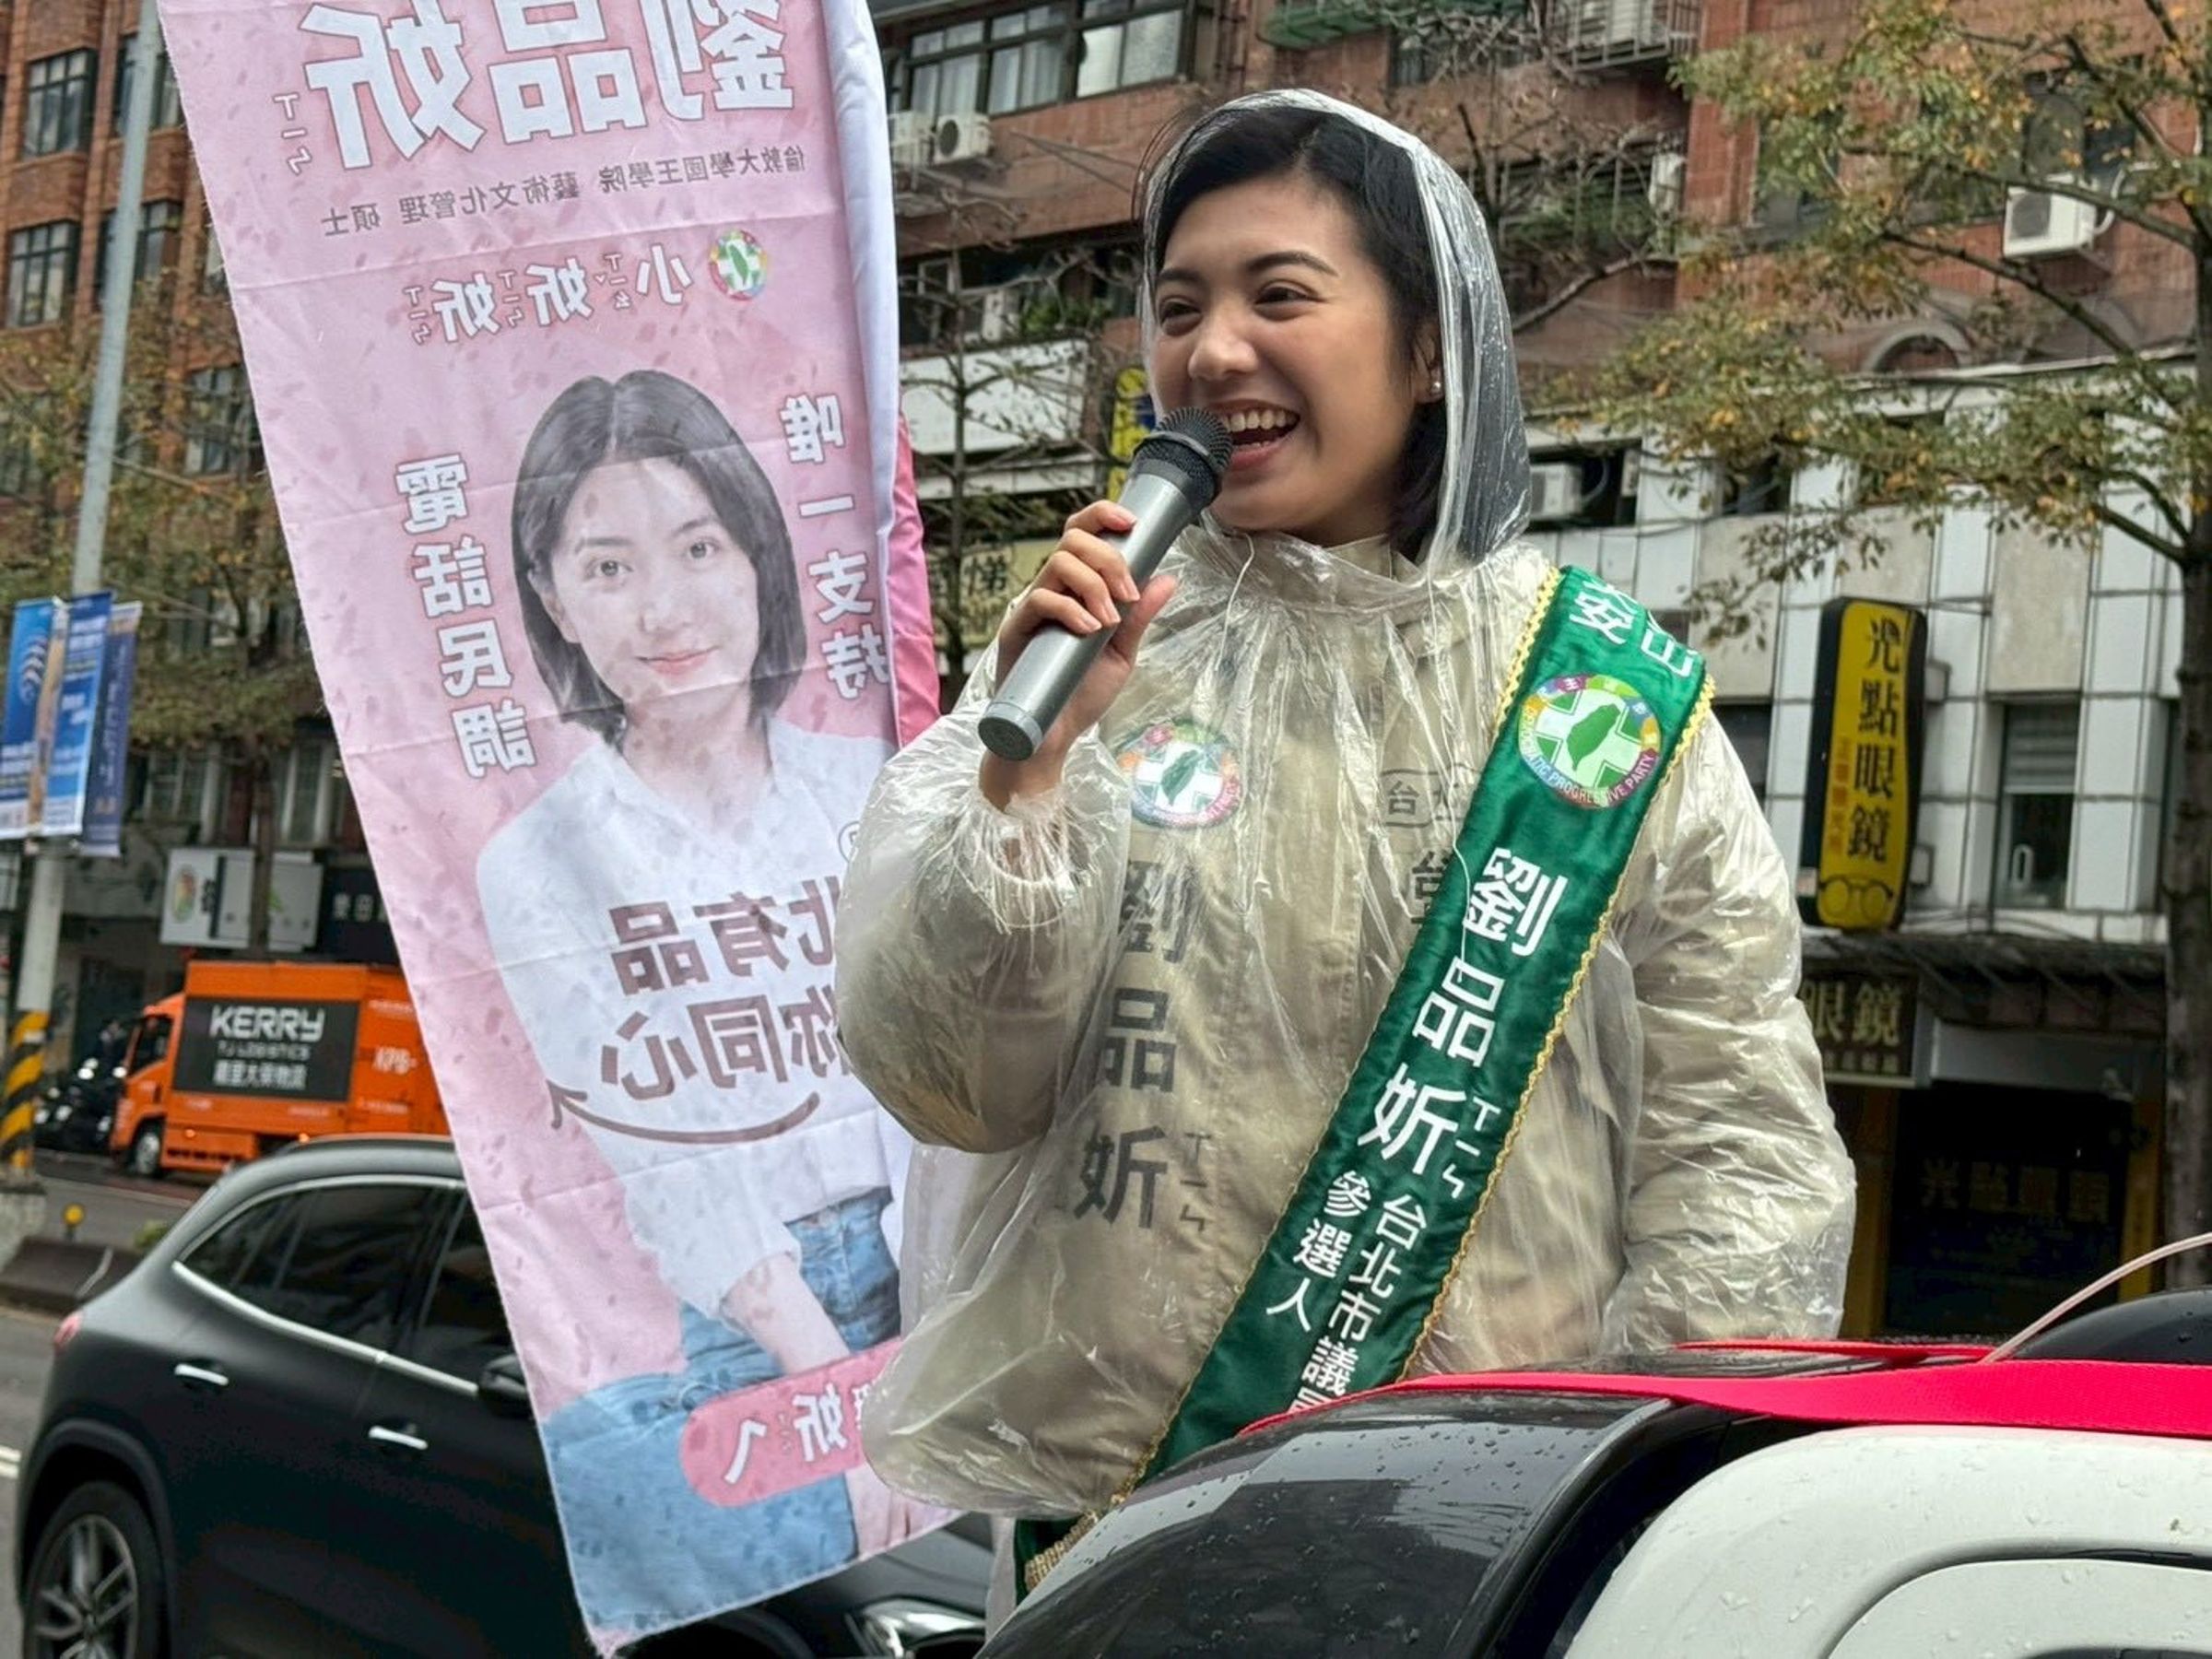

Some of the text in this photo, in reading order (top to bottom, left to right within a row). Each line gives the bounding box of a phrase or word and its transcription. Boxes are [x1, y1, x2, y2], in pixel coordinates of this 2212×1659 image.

[1625, 755, 1657, 791] PARTY
[1848, 616, 1901, 865] 光點眼鏡
[209, 1006, 326, 1042] KERRY
[1358, 848, 1569, 1176] 劉品妡
[1265, 1170, 1372, 1333] 參選人
